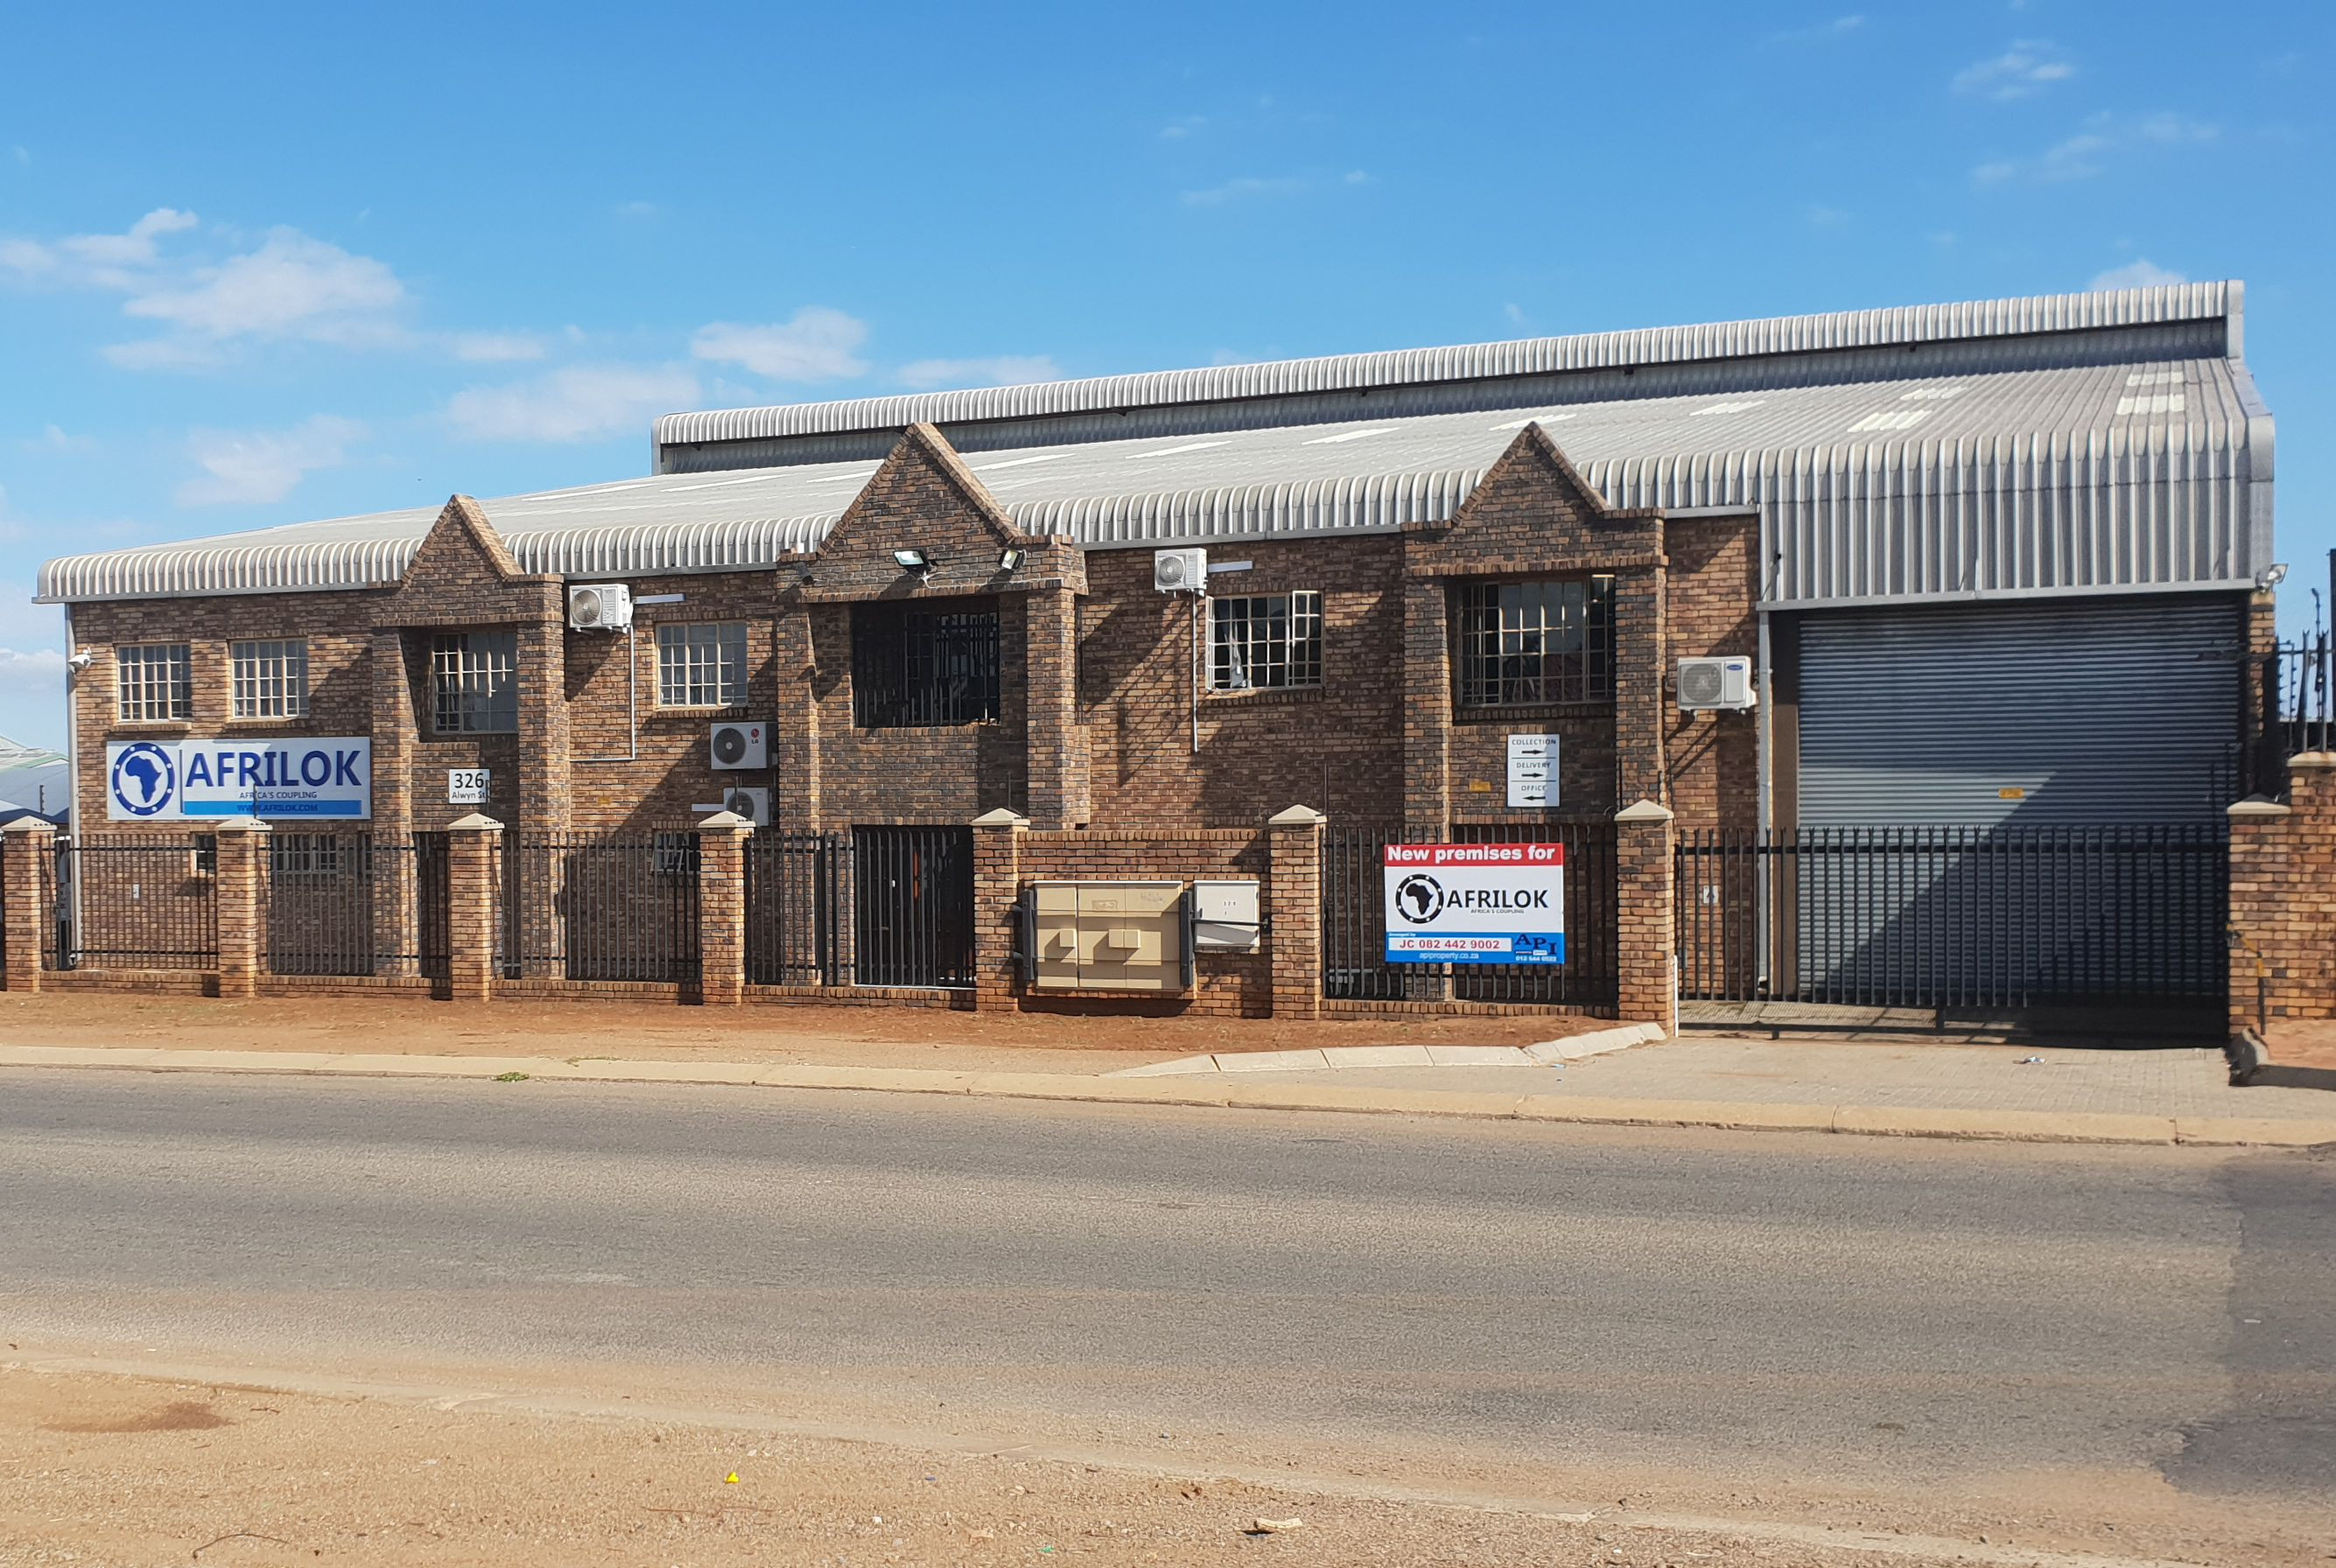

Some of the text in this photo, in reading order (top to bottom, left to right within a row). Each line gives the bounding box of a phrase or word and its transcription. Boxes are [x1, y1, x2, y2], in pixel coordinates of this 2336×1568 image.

[186, 750, 362, 788] AFRILOK
[455, 773, 484, 788] 326
[452, 791, 476, 801] Alwyn
[1387, 845, 1555, 864] New premises for
[1446, 890, 1548, 908] AFRILOK
[1399, 940, 1500, 949] JC 082 442 9002
[1515, 934, 1557, 955] API
